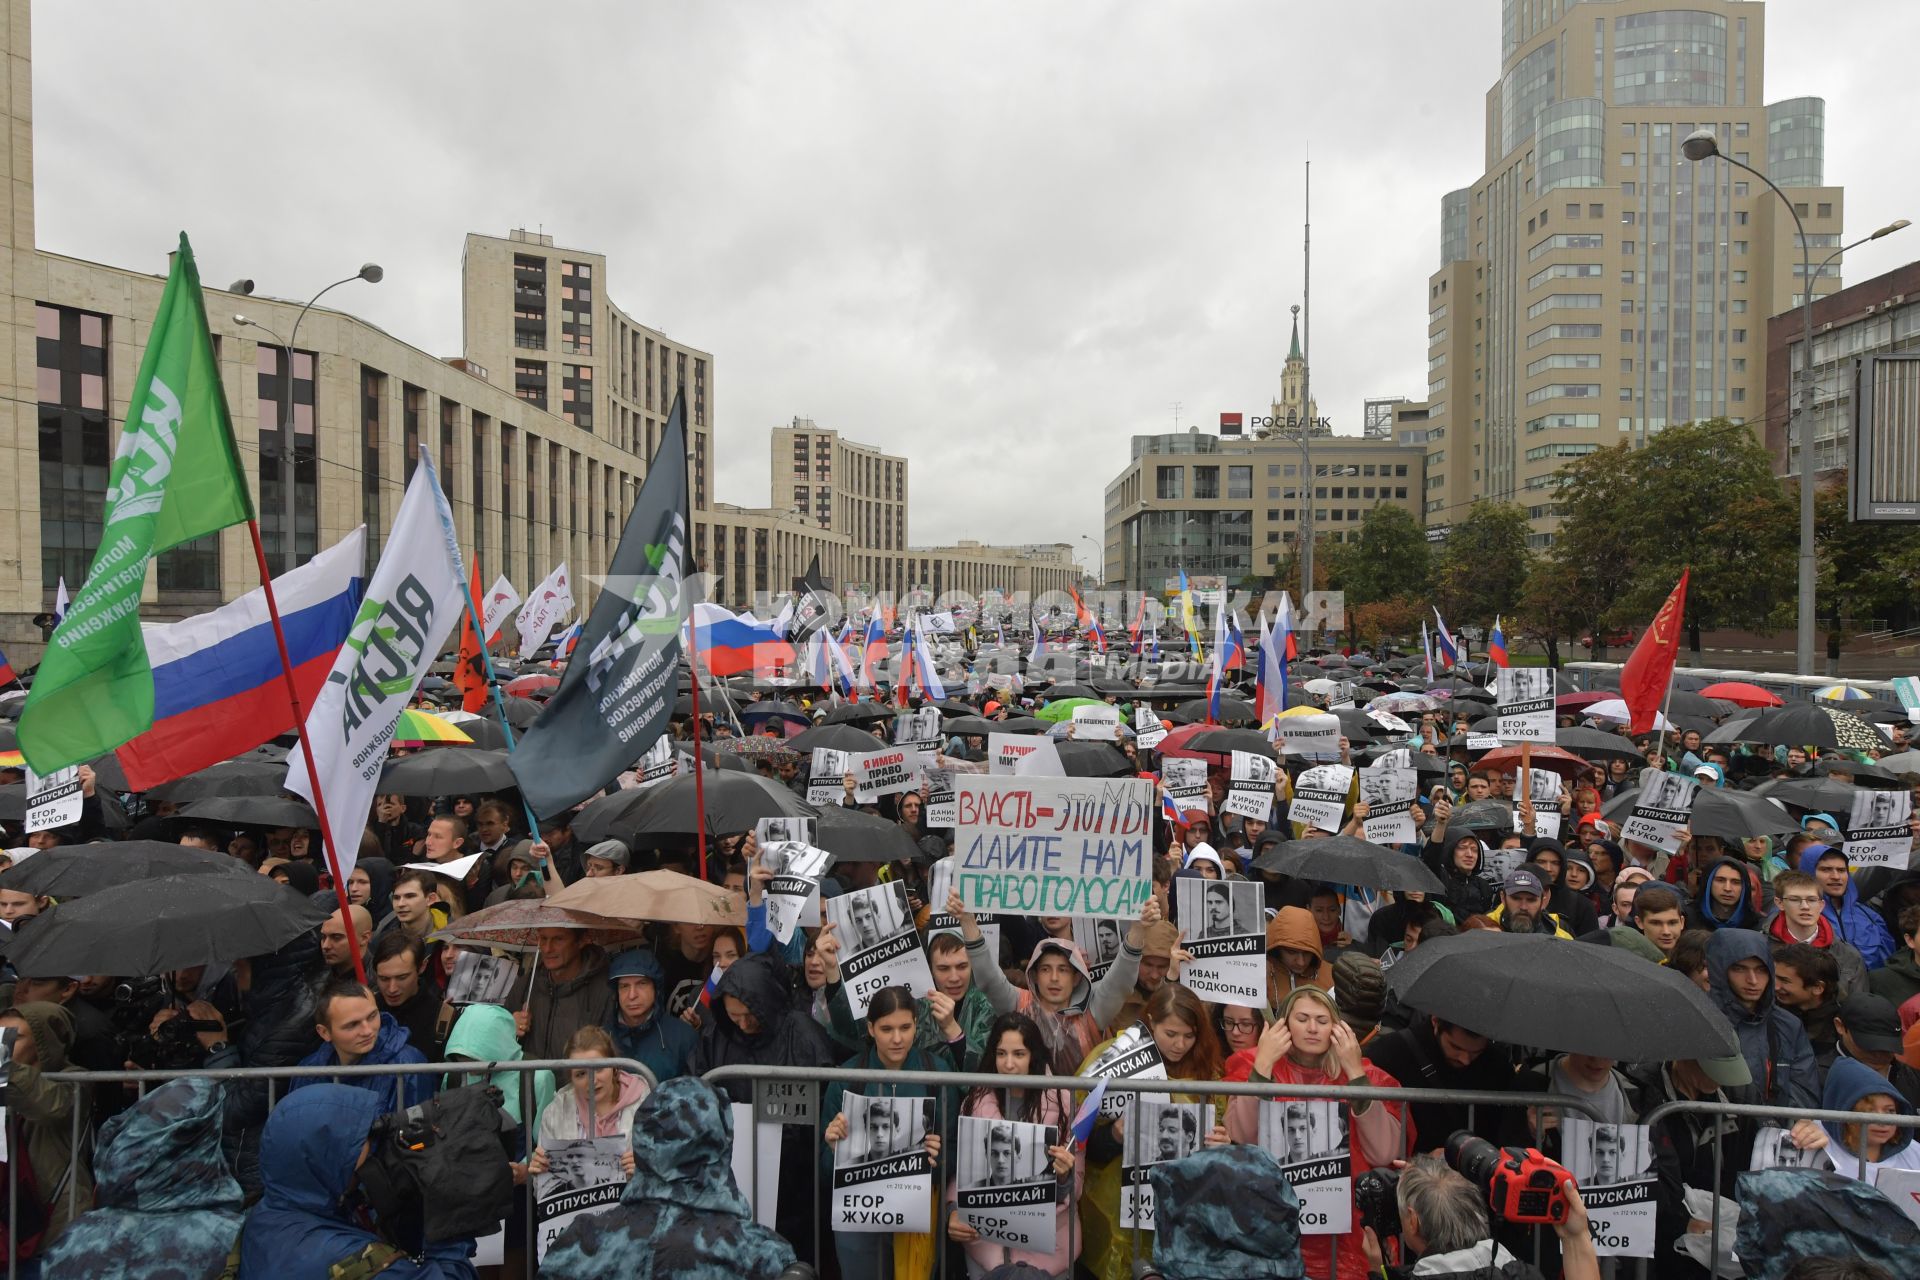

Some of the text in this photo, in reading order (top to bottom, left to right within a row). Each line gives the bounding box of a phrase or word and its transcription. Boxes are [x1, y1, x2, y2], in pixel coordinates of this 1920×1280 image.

[1502, 700, 1549, 715] ОТПУСКАЙ!
[1502, 720, 1527, 728] ЕГОР
[1502, 728, 1540, 736] ЖУКОВ
[864, 759, 871, 770] Я
[872, 752, 904, 769] ИМЕЮ
[869, 764, 902, 780] ПРАВО
[860, 772, 914, 792] НА ВЫБОР!
[1234, 782, 1271, 791] ОТПУСКАЙ!
[31, 783, 77, 807] ОТПУСКАЙ!
[1171, 787, 1203, 797] ТПУСКАЙ!
[1298, 790, 1342, 802] ОТПУСКАЙ!
[1231, 802, 1260, 815] ЖУКОВ
[1232, 794, 1265, 809] КИРИЛЛ
[32, 808, 57, 820] ЕГОР
[1294, 803, 1329, 818] ДАНИИЛ
[1294, 811, 1321, 823] КОНОН
[1638, 808, 1687, 822] ОТПУСКАЙ!
[31, 813, 68, 827] ЖУКОВ
[1367, 822, 1401, 832] ДАНИИЛ
[1630, 820, 1657, 833] ЕГОР
[1368, 832, 1394, 840] КОНОН
[1626, 827, 1664, 844] ЖУКОВ
[1852, 828, 1908, 840] ОТПУСКАЙ!
[962, 834, 1142, 877] ДАЙТЕ НАМ
[1850, 846, 1877, 854] ЕГОР
[1848, 854, 1889, 862] ЖУКОВ
[1188, 938, 1257, 956] ОТПУСКАЙ!
[850, 937, 912, 974] ОТПУСКАЙ!
[1189, 968, 1219, 980] ИВАН
[855, 975, 890, 995] ЕГОР
[1190, 980, 1258, 997] ПОДКОПАЕВ
[1099, 1050, 1154, 1078] ТПУСКАЙ!
[844, 1155, 922, 1183] ОТПУСКАЙ!
[1284, 1161, 1342, 1183] ПУСКАЙ!
[546, 1186, 621, 1216] ОТПУСКАЙ!
[844, 1194, 885, 1209] ЕГОР
[968, 1186, 1046, 1205] ОТПУСКАЙ!
[1580, 1185, 1648, 1205] ТПУСКАЙ!
[842, 1210, 904, 1225] ЖУКОВ
[968, 1214, 1008, 1229] ЕГОР
[1299, 1213, 1328, 1225] КОВ
[1597, 1235, 1630, 1248] КОВ
